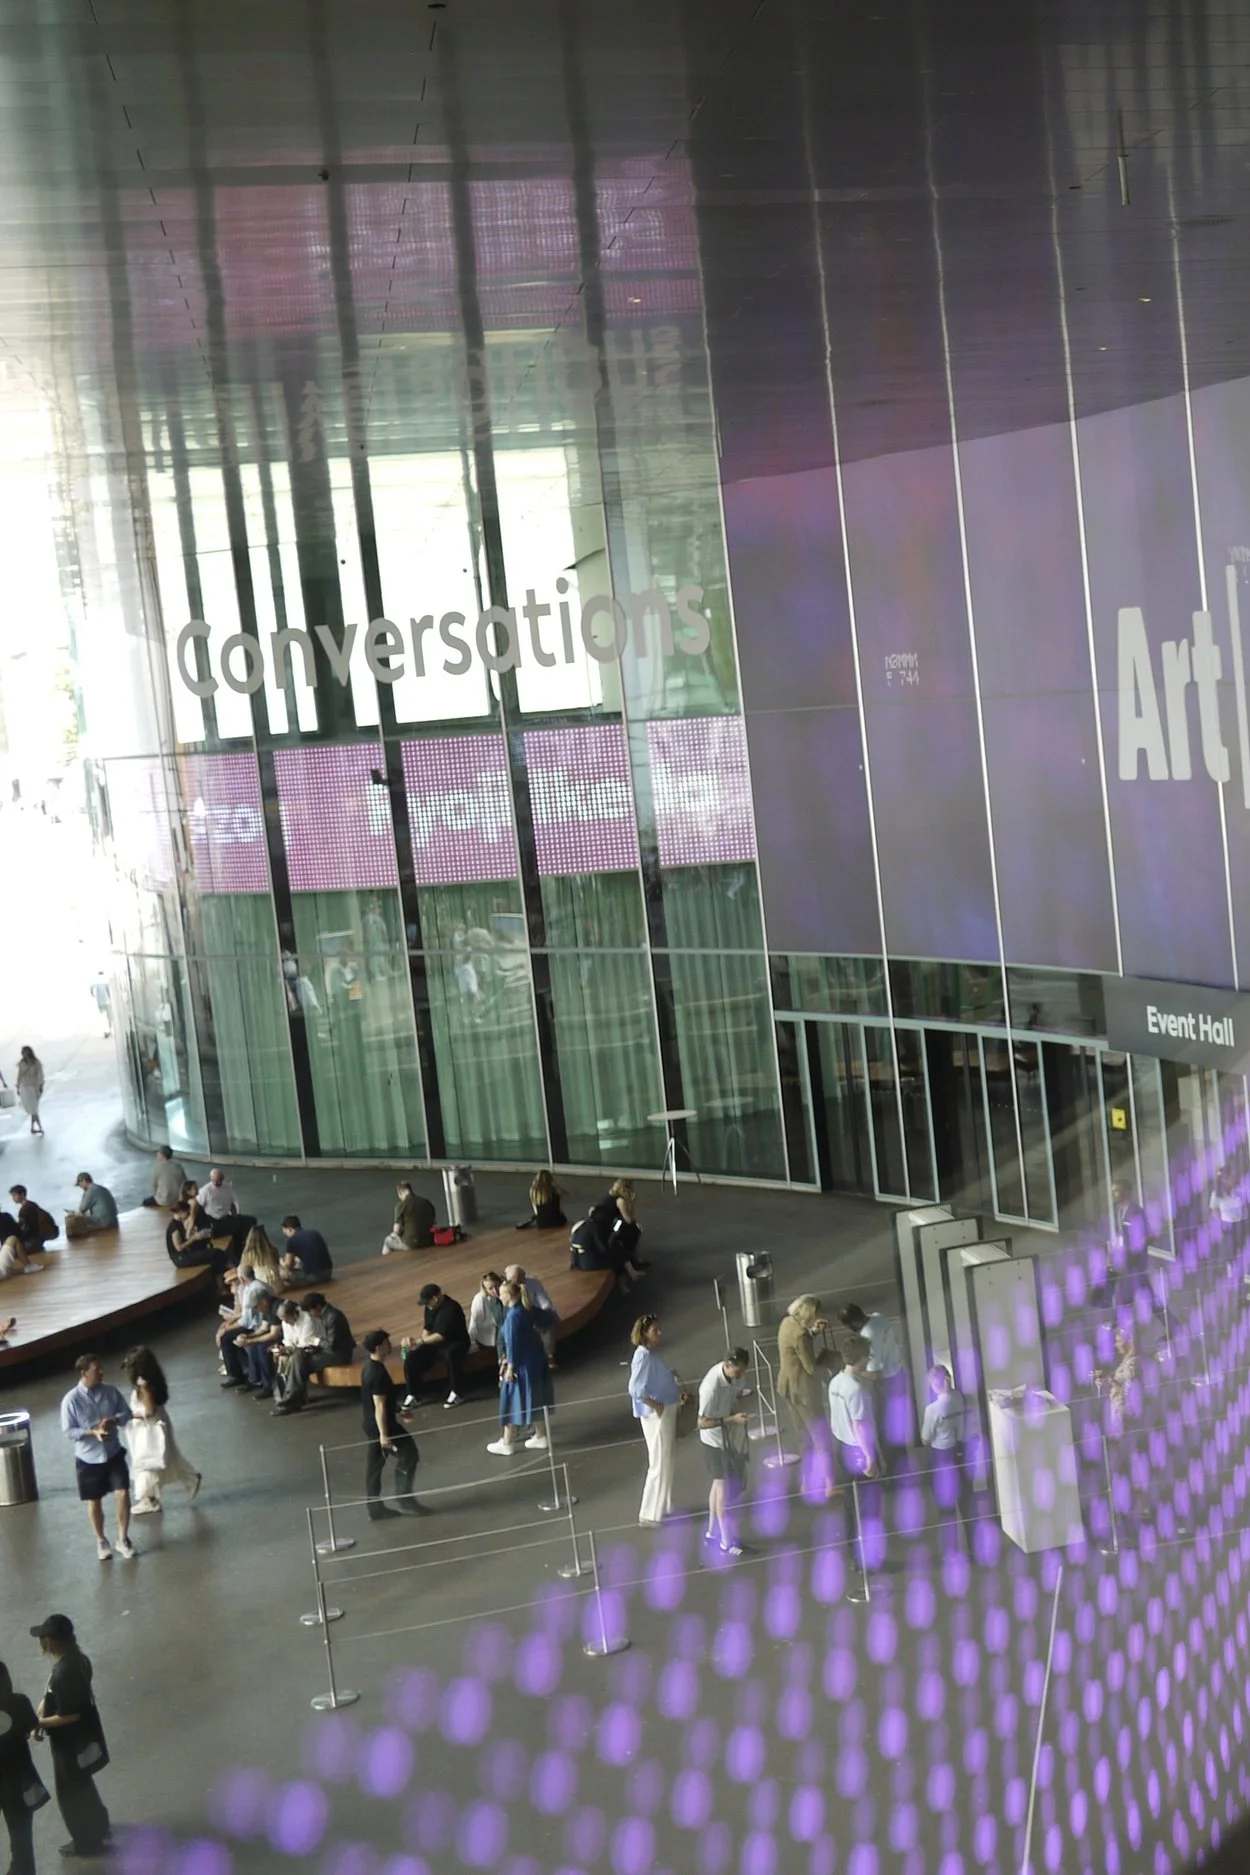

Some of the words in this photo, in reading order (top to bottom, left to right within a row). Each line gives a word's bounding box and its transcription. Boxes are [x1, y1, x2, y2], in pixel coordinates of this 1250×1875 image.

[176, 576, 712, 698] Conversations
[1146, 1005, 1197, 1041] Event
[1198, 1013, 1235, 1048] Hall
